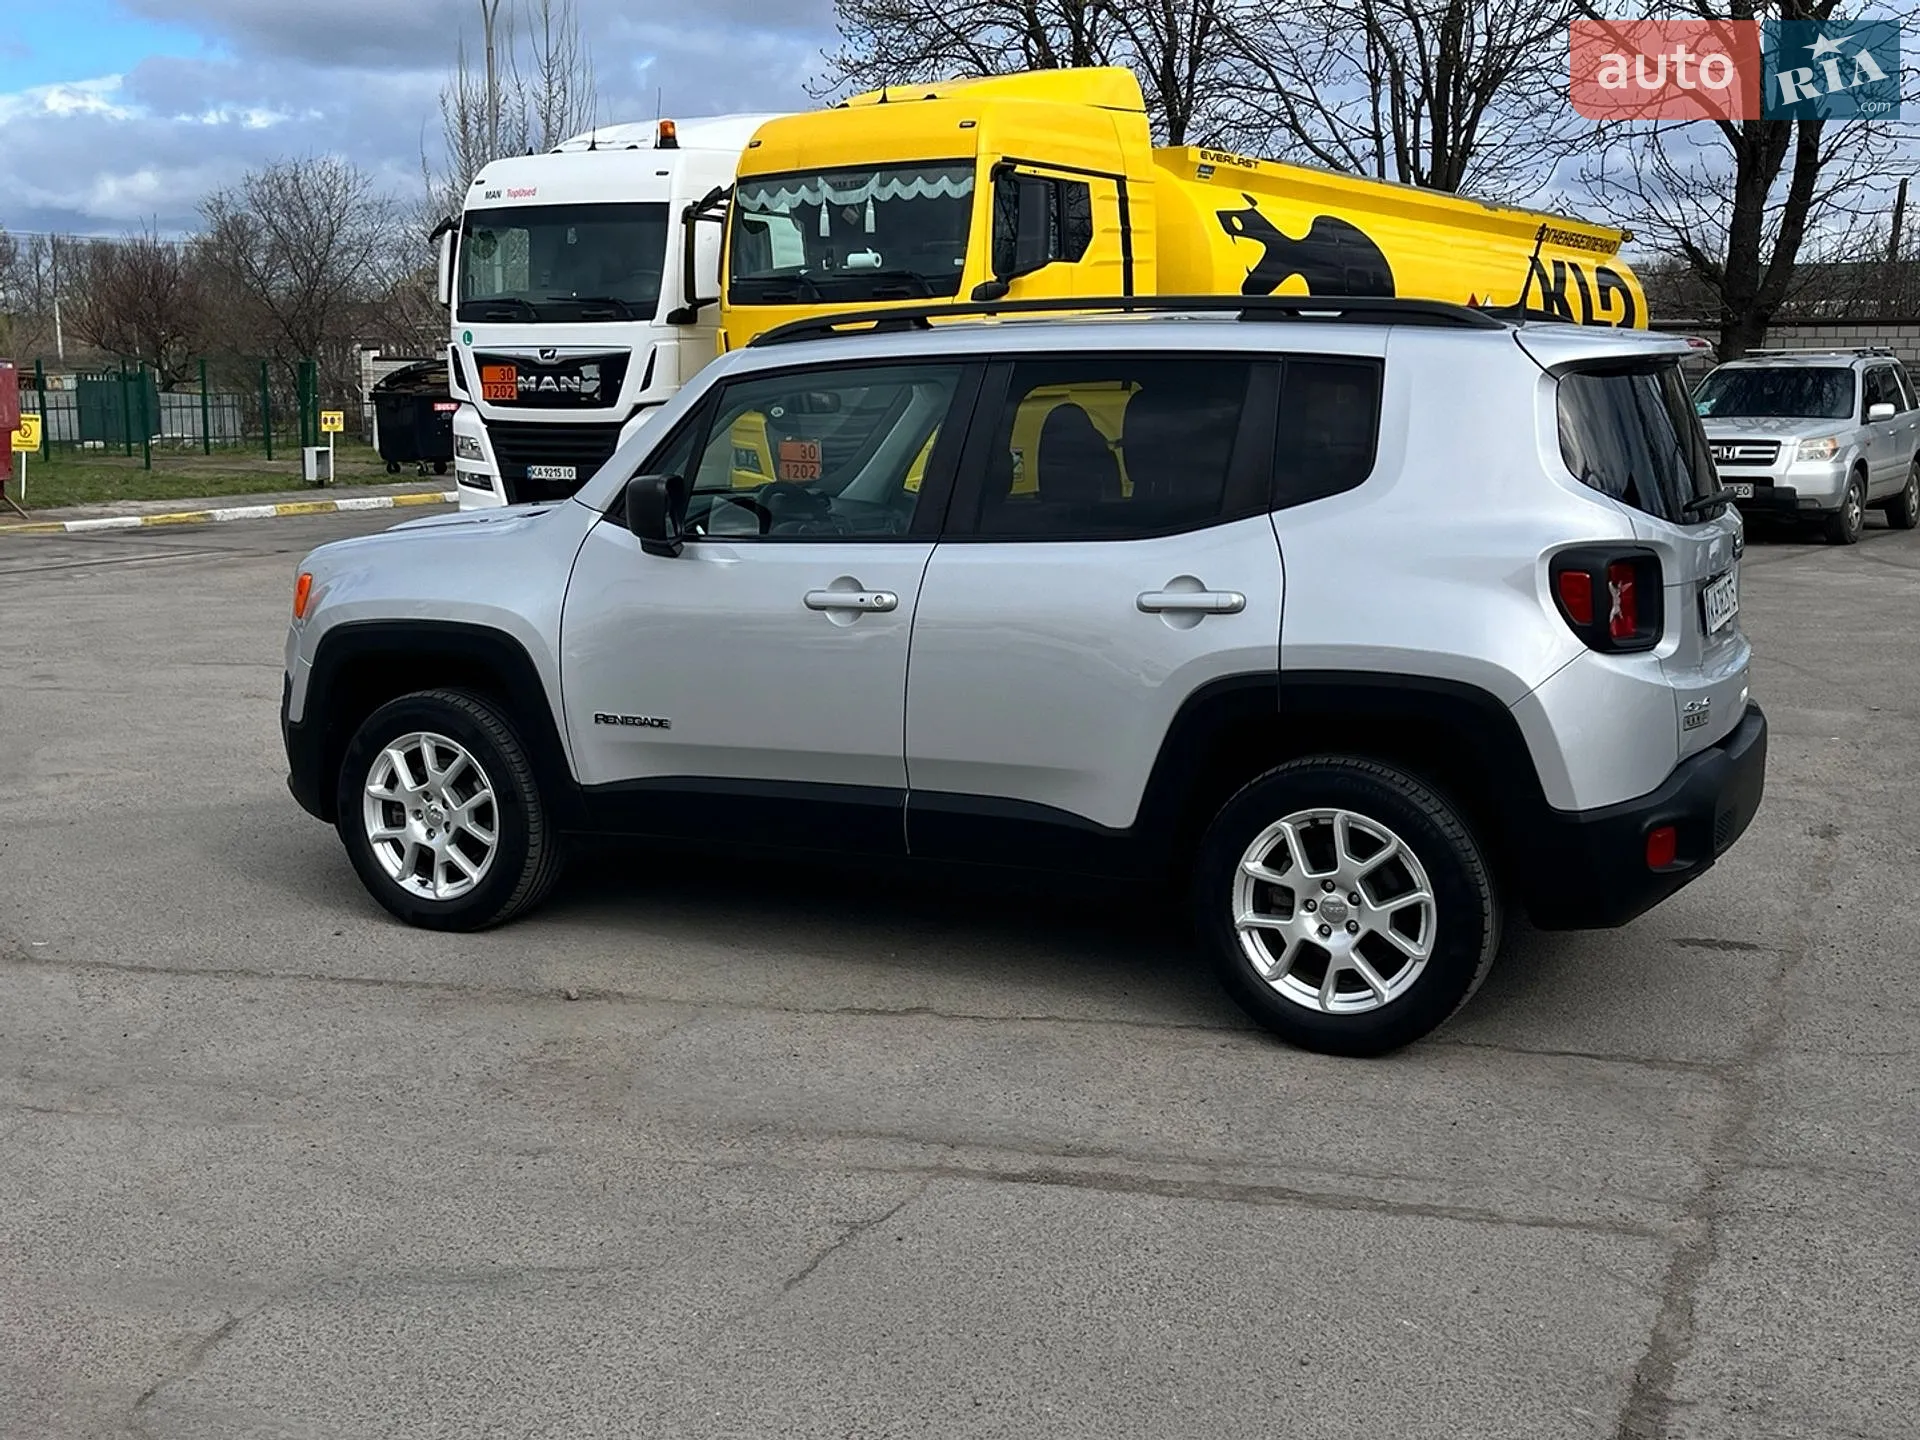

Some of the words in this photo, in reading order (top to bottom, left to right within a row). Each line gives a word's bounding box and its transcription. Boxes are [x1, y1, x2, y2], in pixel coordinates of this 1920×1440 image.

[1200, 150, 1260, 169] EVERLAST
[484, 190, 502, 200] MAN
[499, 367, 514, 381] 30
[486, 385, 514, 399] 1202
[517, 376, 580, 392] MAN
[800, 444, 817, 460] 30
[785, 463, 817, 480] 1202
[594, 713, 671, 730] RENEGADE
